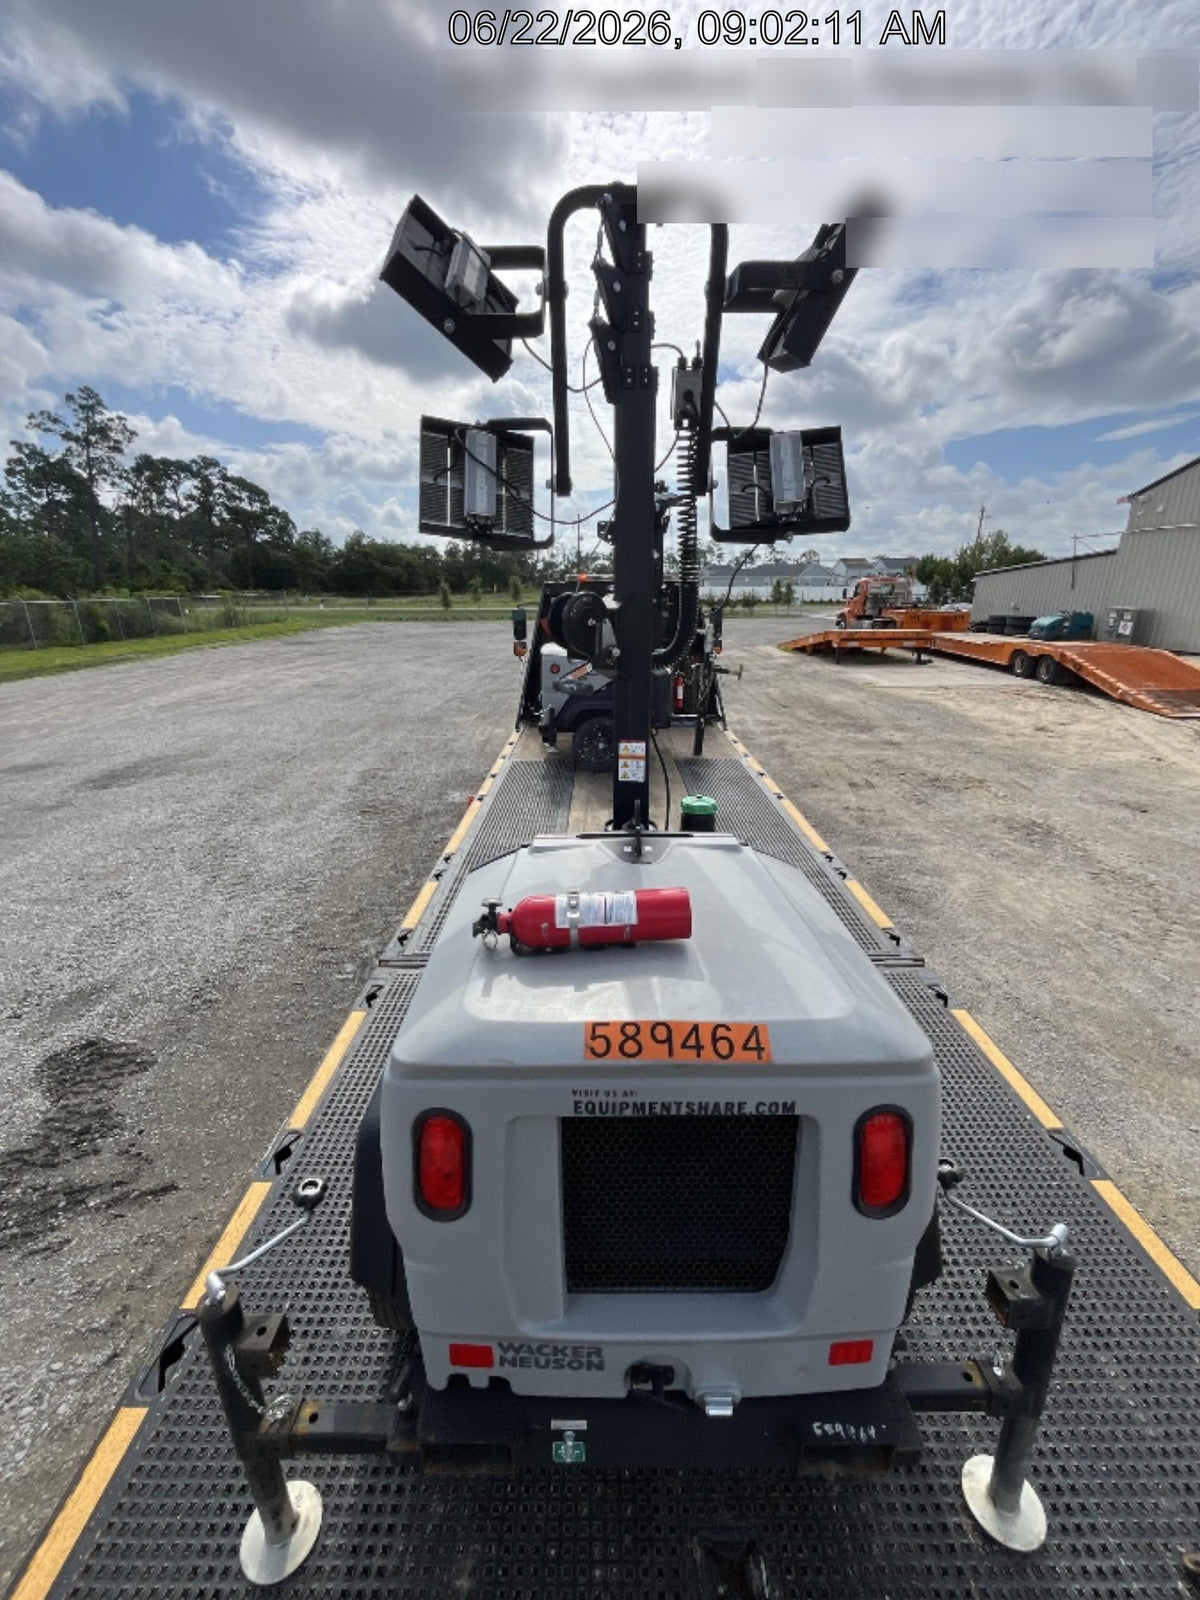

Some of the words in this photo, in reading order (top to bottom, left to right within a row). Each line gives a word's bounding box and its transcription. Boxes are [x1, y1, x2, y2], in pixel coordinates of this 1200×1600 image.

[589, 1022, 765, 1060] 589464
[572, 1089, 600, 1098] VISIT
[573, 1100, 796, 1116] EQUIPMENTSHARE.COM
[497, 1341, 604, 1359] WACKER
[498, 1354, 605, 1372] NEUSON
